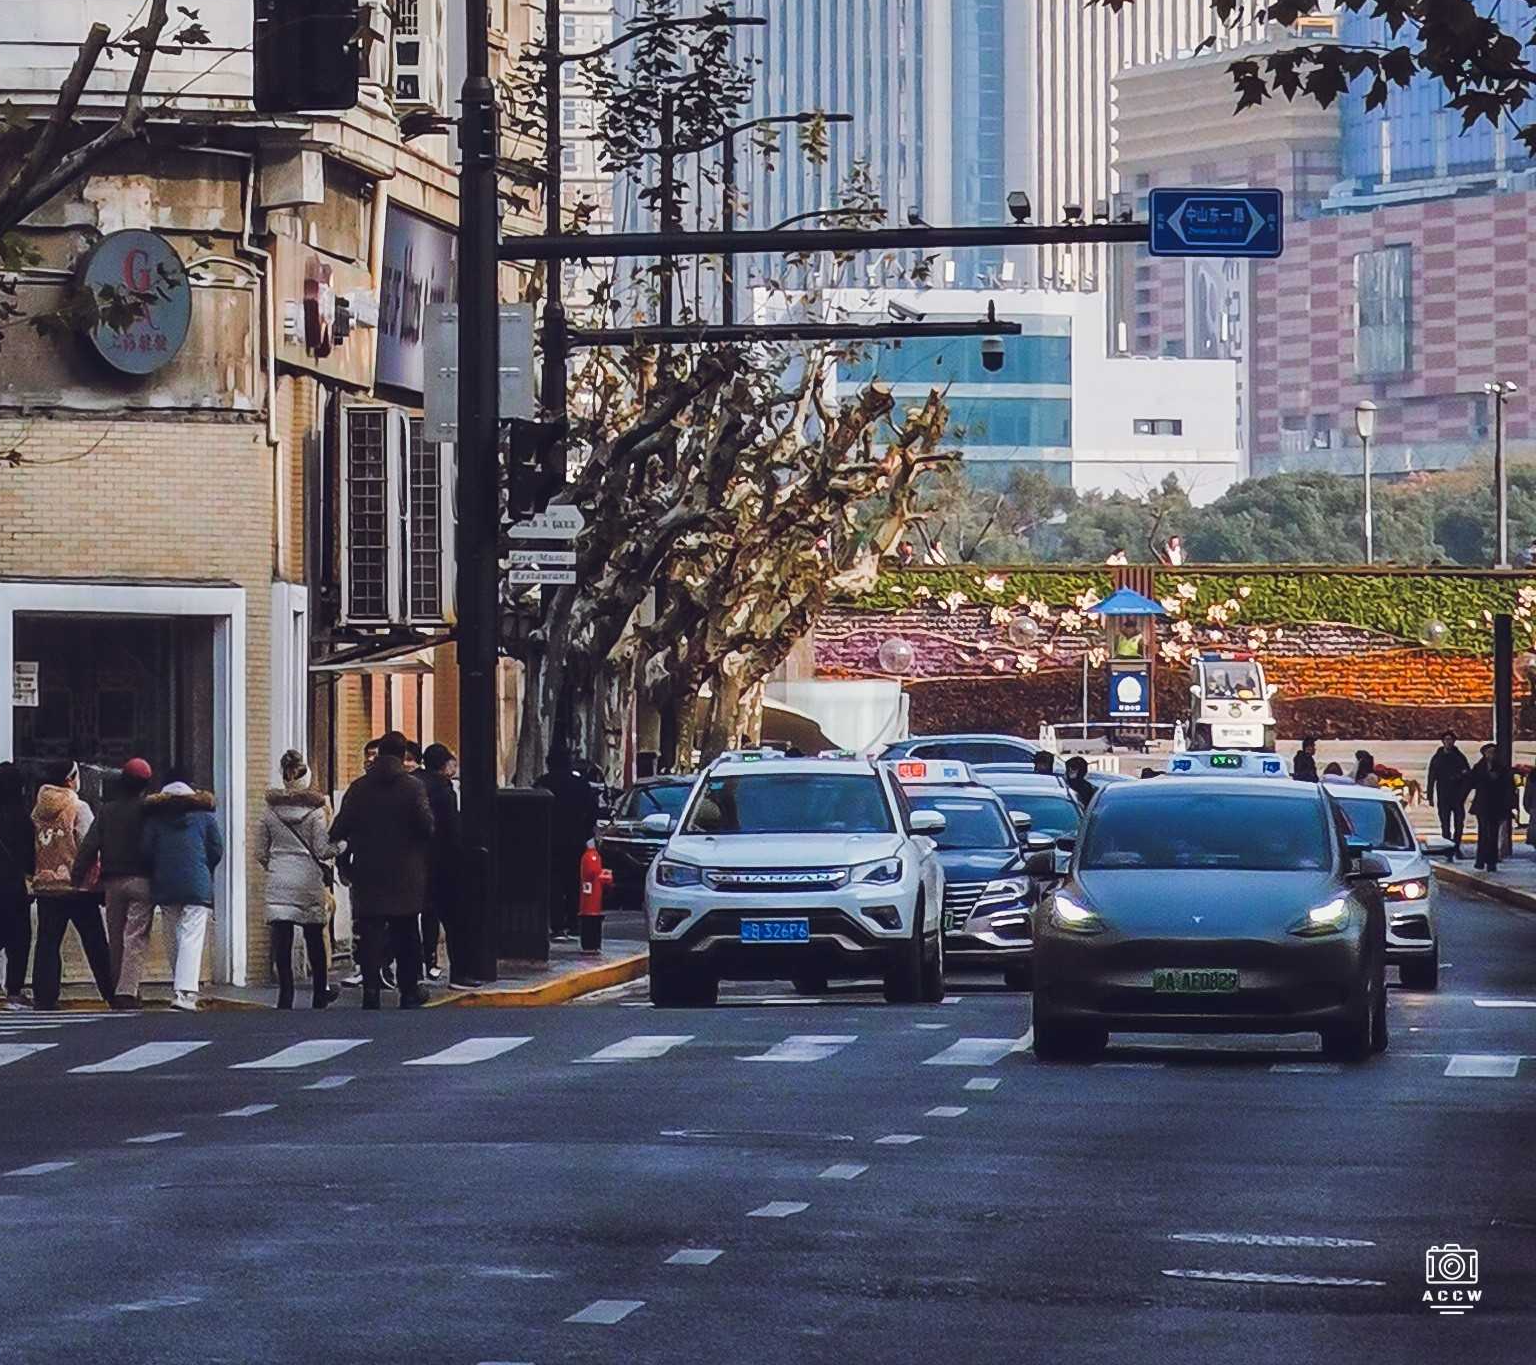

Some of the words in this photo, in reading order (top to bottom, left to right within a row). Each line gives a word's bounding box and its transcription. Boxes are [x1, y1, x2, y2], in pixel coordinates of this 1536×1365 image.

[1185, 205, 1245, 224] 中山东一路
